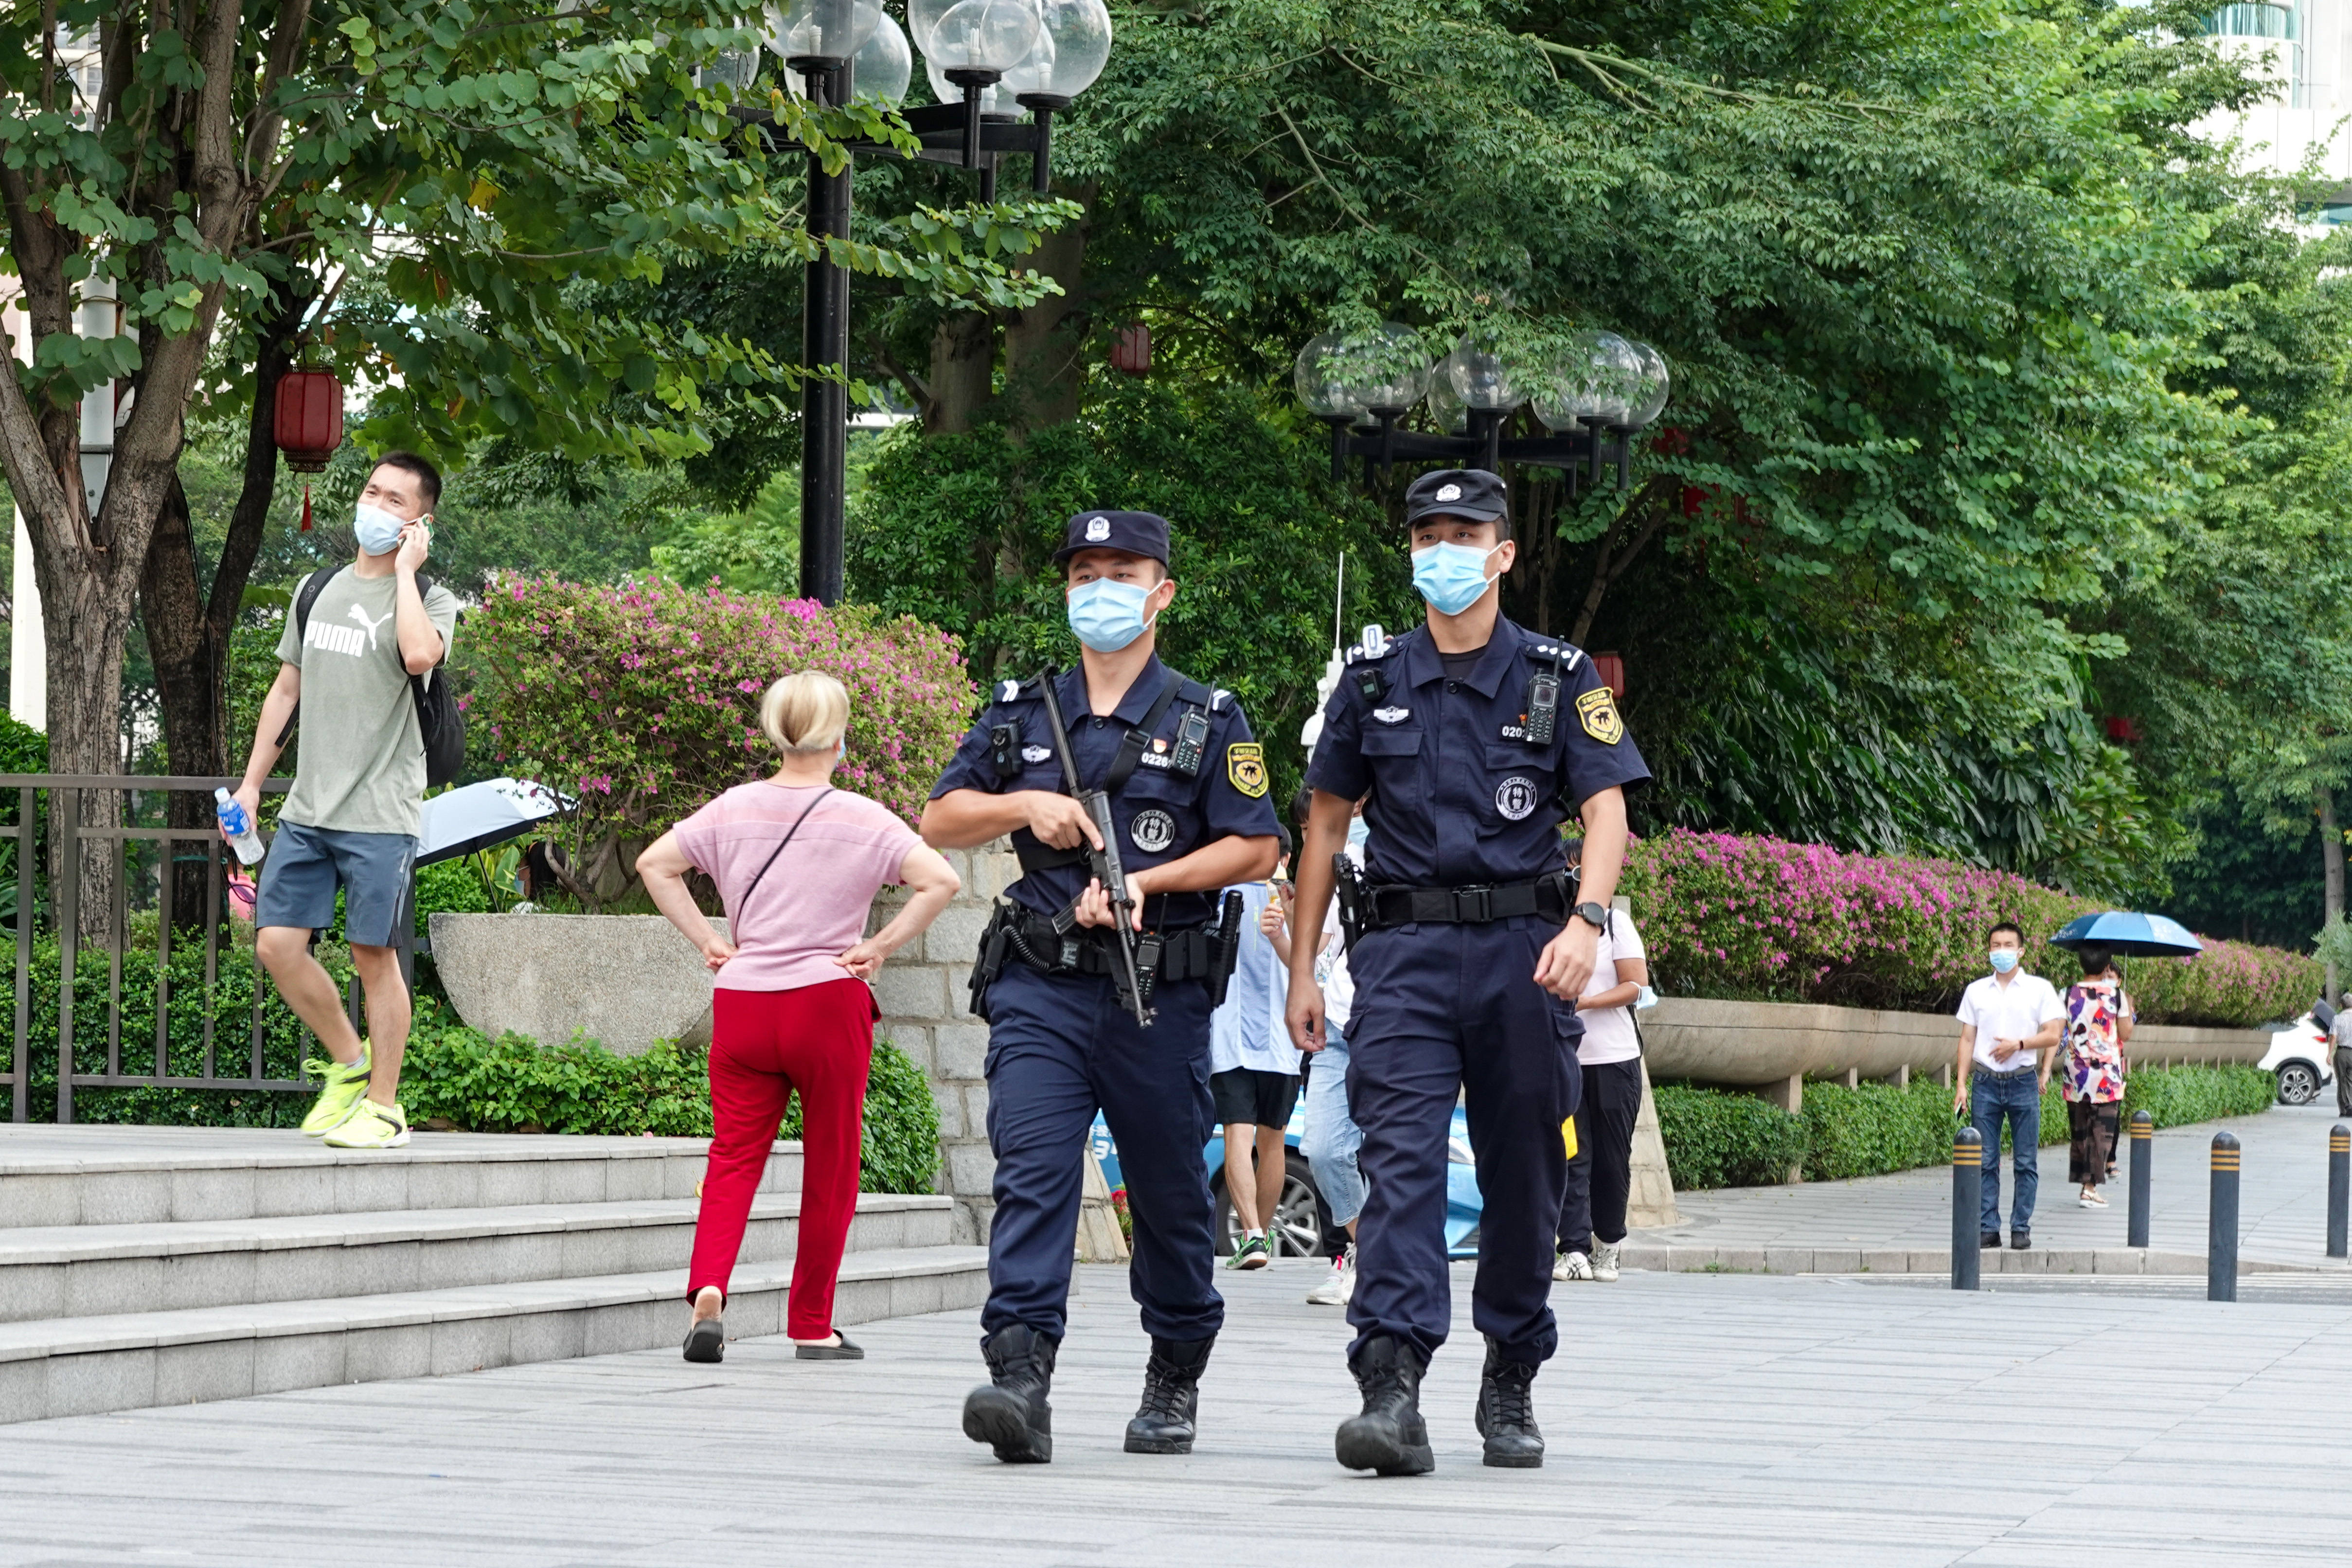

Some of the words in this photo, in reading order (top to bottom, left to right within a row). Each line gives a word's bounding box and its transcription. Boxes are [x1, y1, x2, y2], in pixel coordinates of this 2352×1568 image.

[303, 620, 366, 658] PUMA
[1502, 726, 1525, 739] 020
[1141, 752, 1171, 767] 0226
